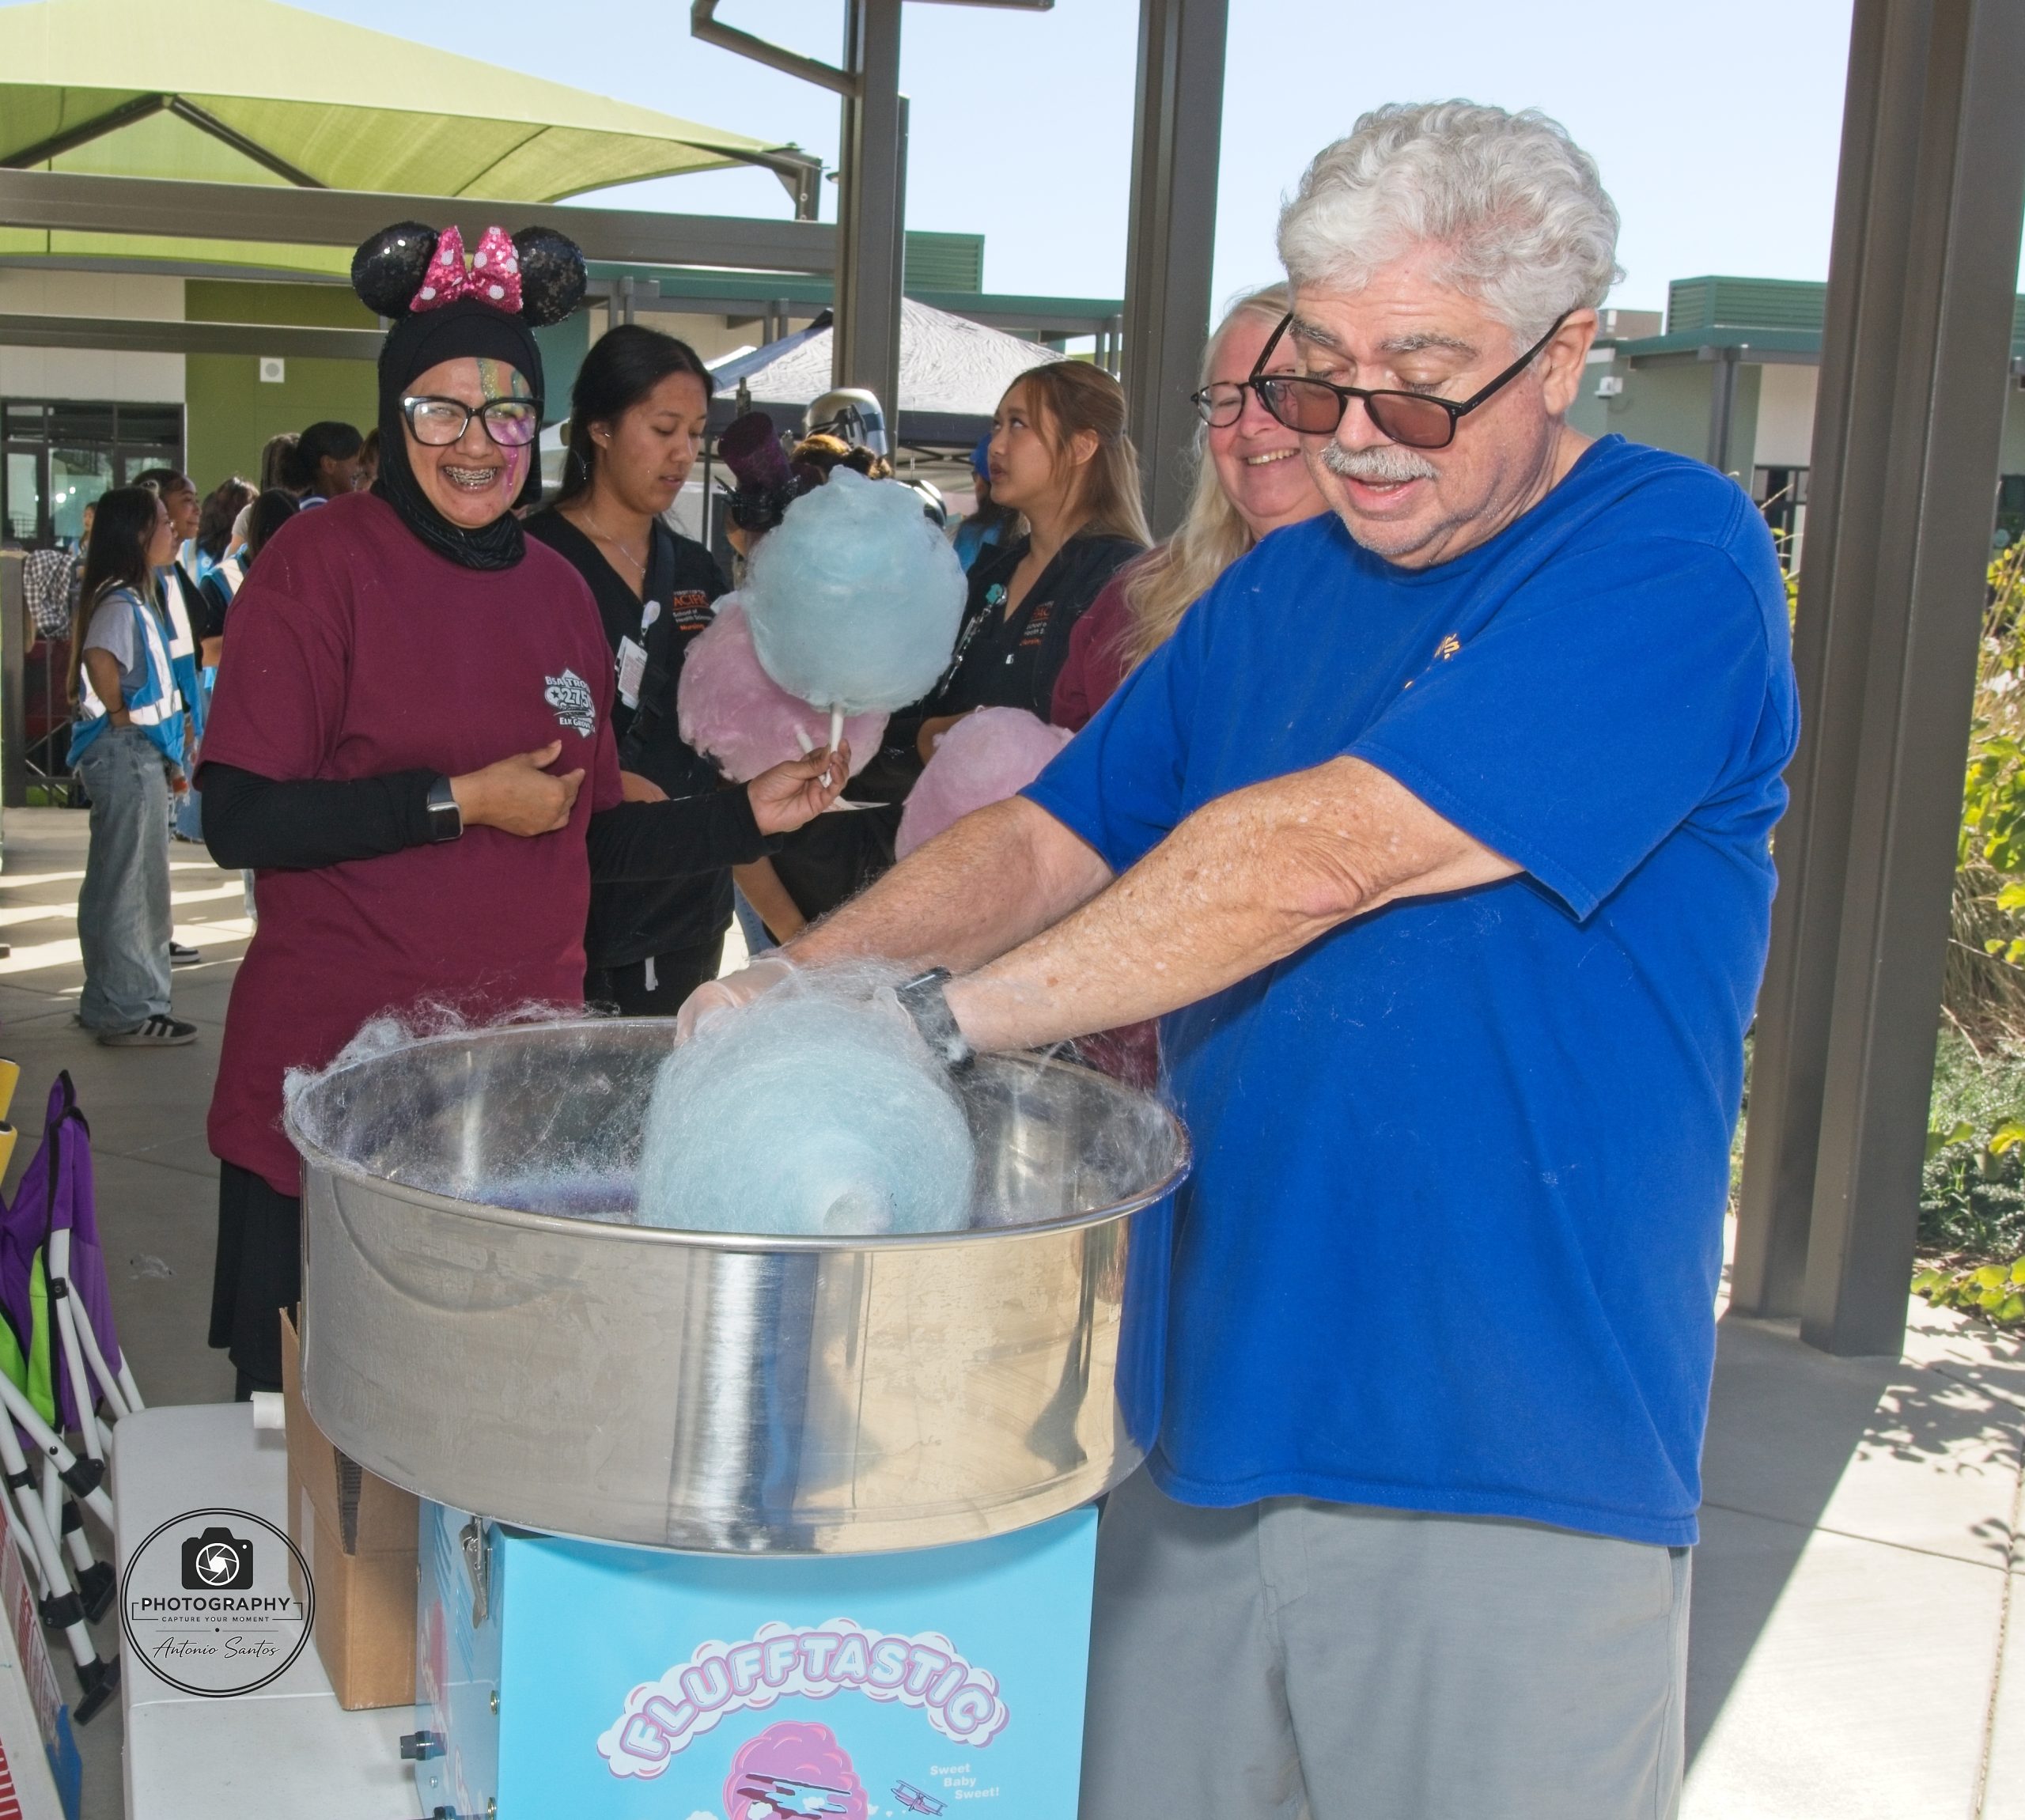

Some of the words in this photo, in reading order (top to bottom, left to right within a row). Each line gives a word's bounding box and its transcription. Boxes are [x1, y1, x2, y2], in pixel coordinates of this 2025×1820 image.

[561, 687, 589, 708] 275
[619, 1631, 998, 1761] FLUFFTASTIC
[930, 1763, 971, 1776] Sweet
[944, 1776, 977, 1788] Baby
[955, 1787, 1000, 1800] Sweet!
